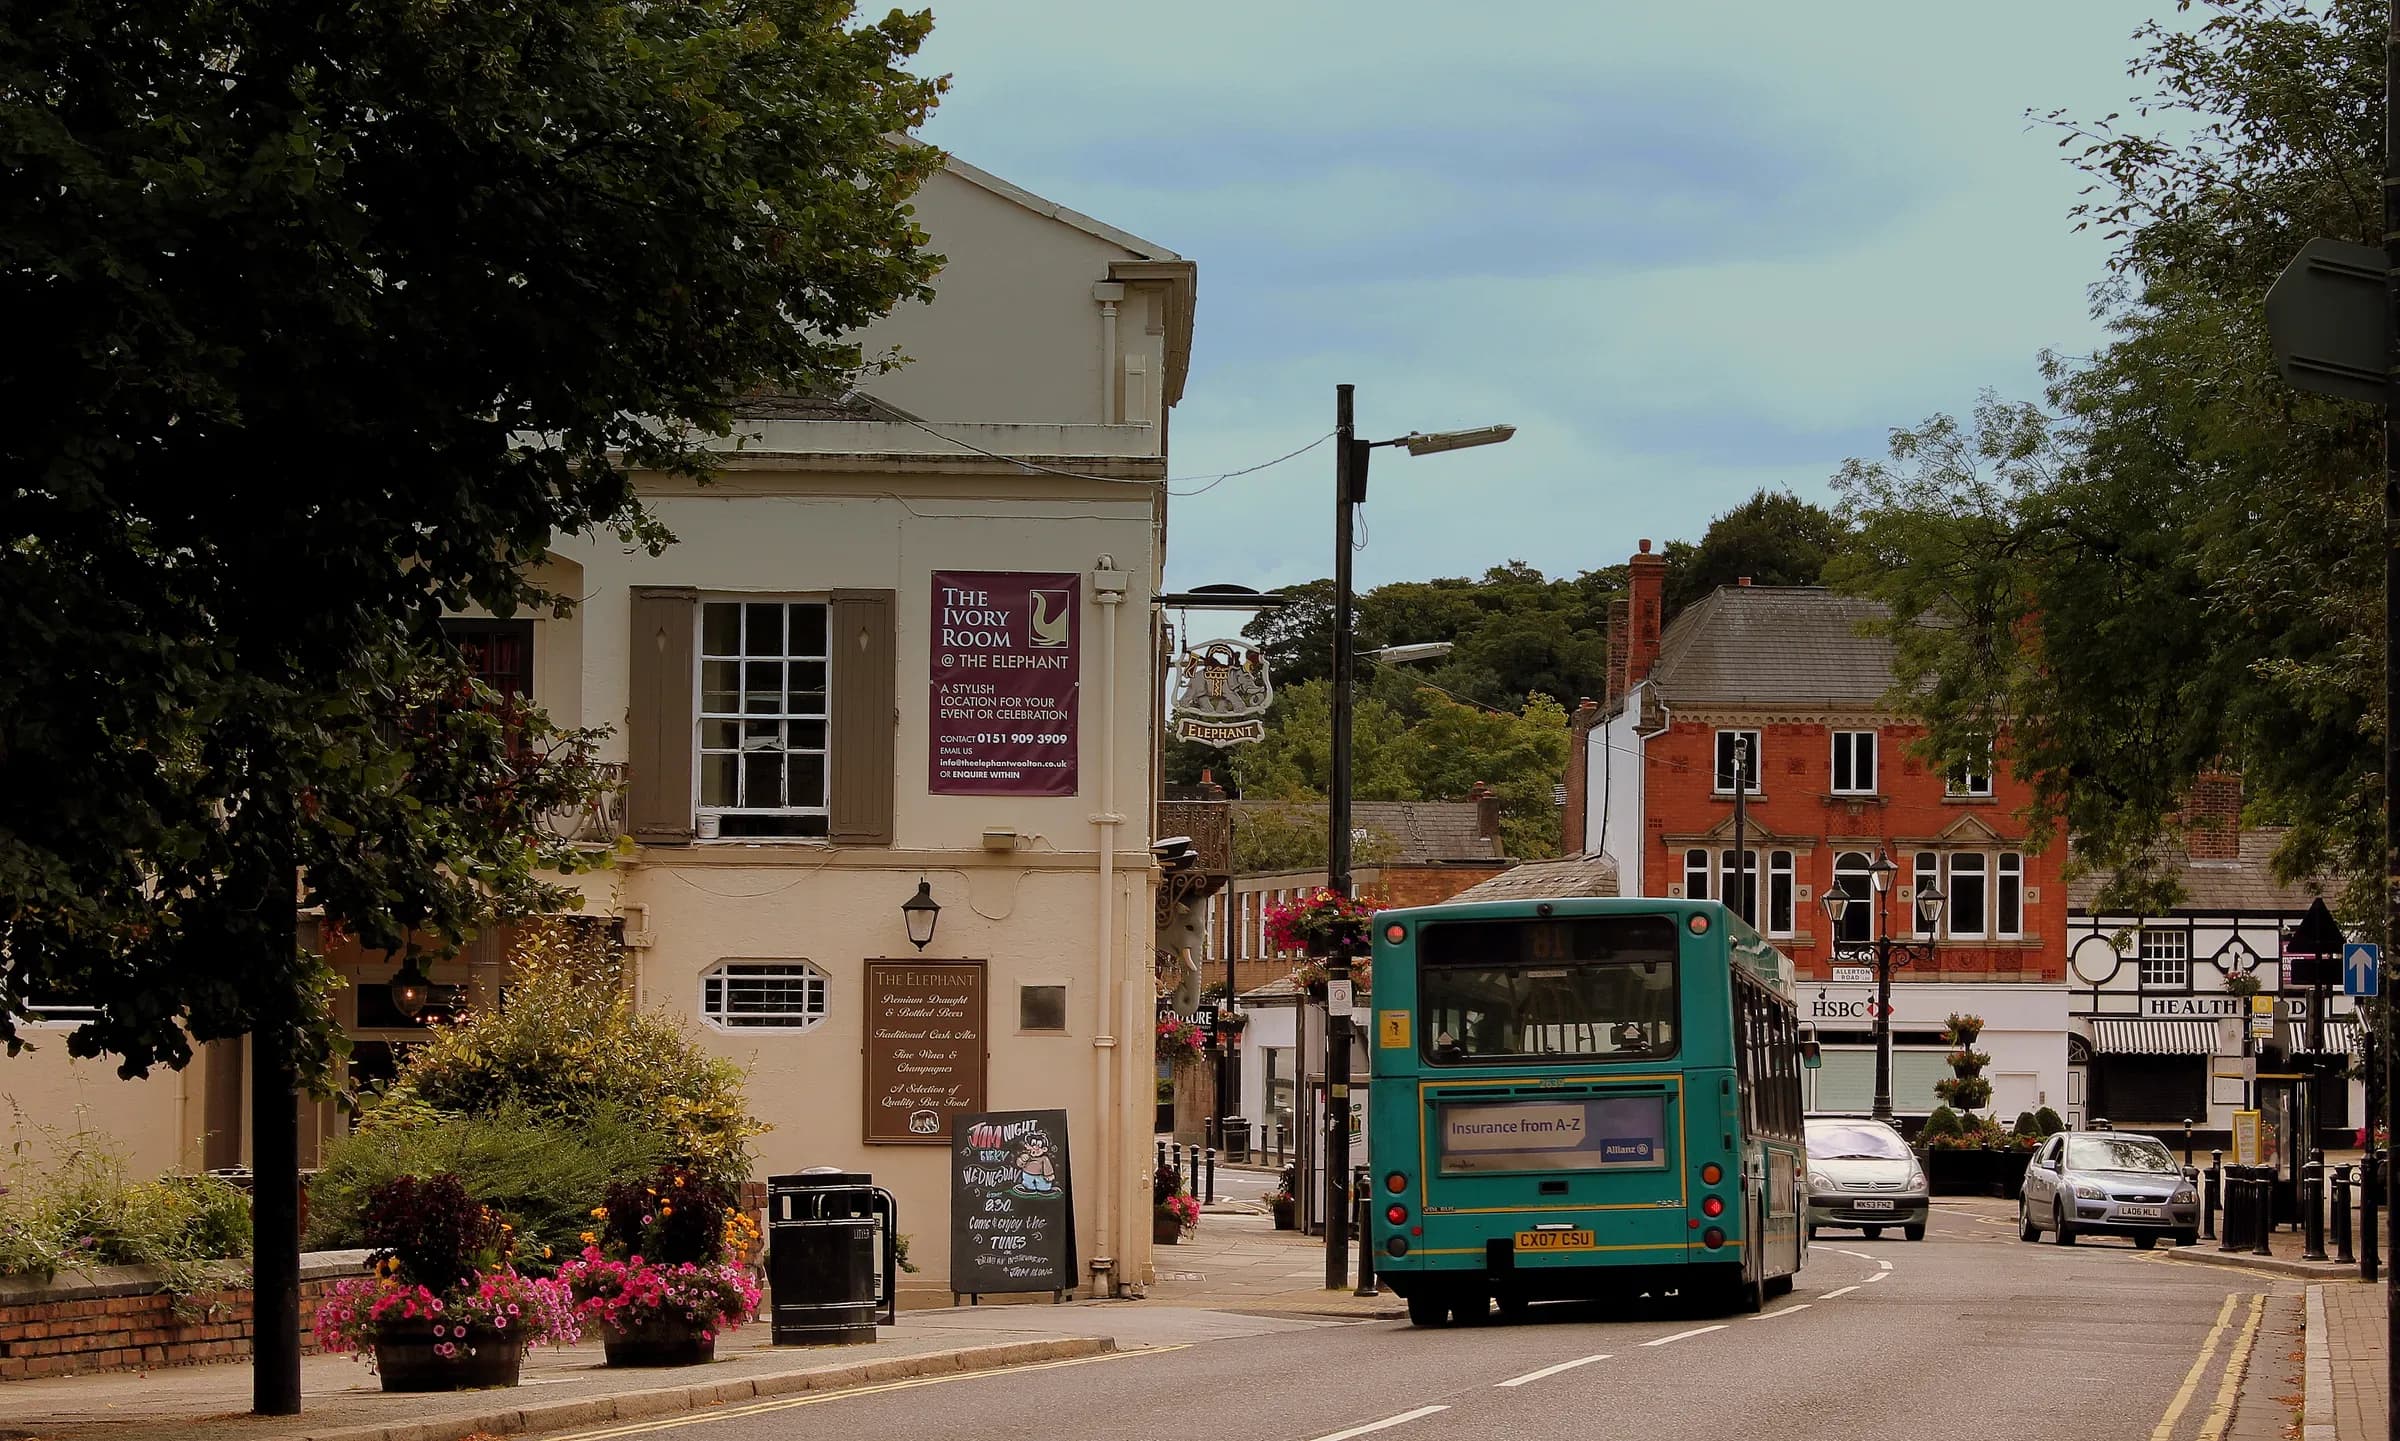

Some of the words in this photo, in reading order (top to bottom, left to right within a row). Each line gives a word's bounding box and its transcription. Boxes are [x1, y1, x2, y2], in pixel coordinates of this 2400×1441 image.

[942, 588, 988, 607] THE
[943, 607, 1010, 626] IVORY
[941, 628, 1012, 647] ROOM
[941, 653, 955, 668] @
[959, 654, 987, 668] THE
[992, 655, 1069, 669] ELEPHANT
[940, 684, 949, 694] A
[952, 684, 995, 694] STYLISH
[940, 696, 997, 707] LOCATION
[1000, 697, 1022, 707] FOR
[1024, 698, 1055, 708] YOUR
[940, 709, 975, 719] EVENT
[977, 709, 993, 719] OR
[996, 710, 1068, 720] CELEBRATION
[1188, 724, 1253, 738] ELEPHANT
[977, 733, 1006, 744] 0151
[1011, 734, 1034, 744] 909
[1037, 734, 1068, 744] 3909
[952, 771, 988, 779] ENQUIRE
[989, 771, 1020, 779] WITHIN
[875, 971, 903, 986] THE
[906, 972, 976, 986] ELEPHANT
[880, 994, 923, 1004] Premium
[927, 993, 968, 1007] Draught
[2152, 1000, 2237, 1014] HEALTH
[885, 1007, 894, 1017] &
[897, 1007, 935, 1018] Bottled
[936, 1007, 963, 1018] Beers
[1812, 1002, 1864, 1017] HSBC
[874, 1028, 927, 1039] Traditional
[929, 1029, 951, 1039] Cask
[954, 1030, 976, 1039] Ales
[892, 1049, 915, 1059] Fine
[918, 1049, 945, 1059] Wines
[948, 1050, 959, 1059] &
[897, 1062, 953, 1075] Champagnes
[889, 1083, 905, 1093] A
[905, 1083, 945, 1094] Selection
[947, 1084, 963, 1096] of
[881, 1096, 915, 1109] Quality
[918, 1096, 940, 1107] Bar
[943, 1096, 970, 1107] Food
[1452, 1121, 1517, 1135] Insurance
[1520, 1119, 1553, 1133] from
[1556, 1117, 1581, 1131] A-Z
[967, 1121, 1004, 1149] JAM
[1003, 1119, 1039, 1142] NIGHT
[1605, 1144, 1637, 1155] Allianz
[963, 1165, 1022, 1187] WEDNESDAY
[2121, 1207, 2142, 1215] LA06
[969, 1215, 991, 1230] Come
[997, 1215, 1023, 1233] enjoy
[1026, 1215, 1047, 1229] the
[990, 1236, 1027, 1250] TUNES
[1520, 1233, 1557, 1247] CX07
[1562, 1232, 1590, 1246] CSU
